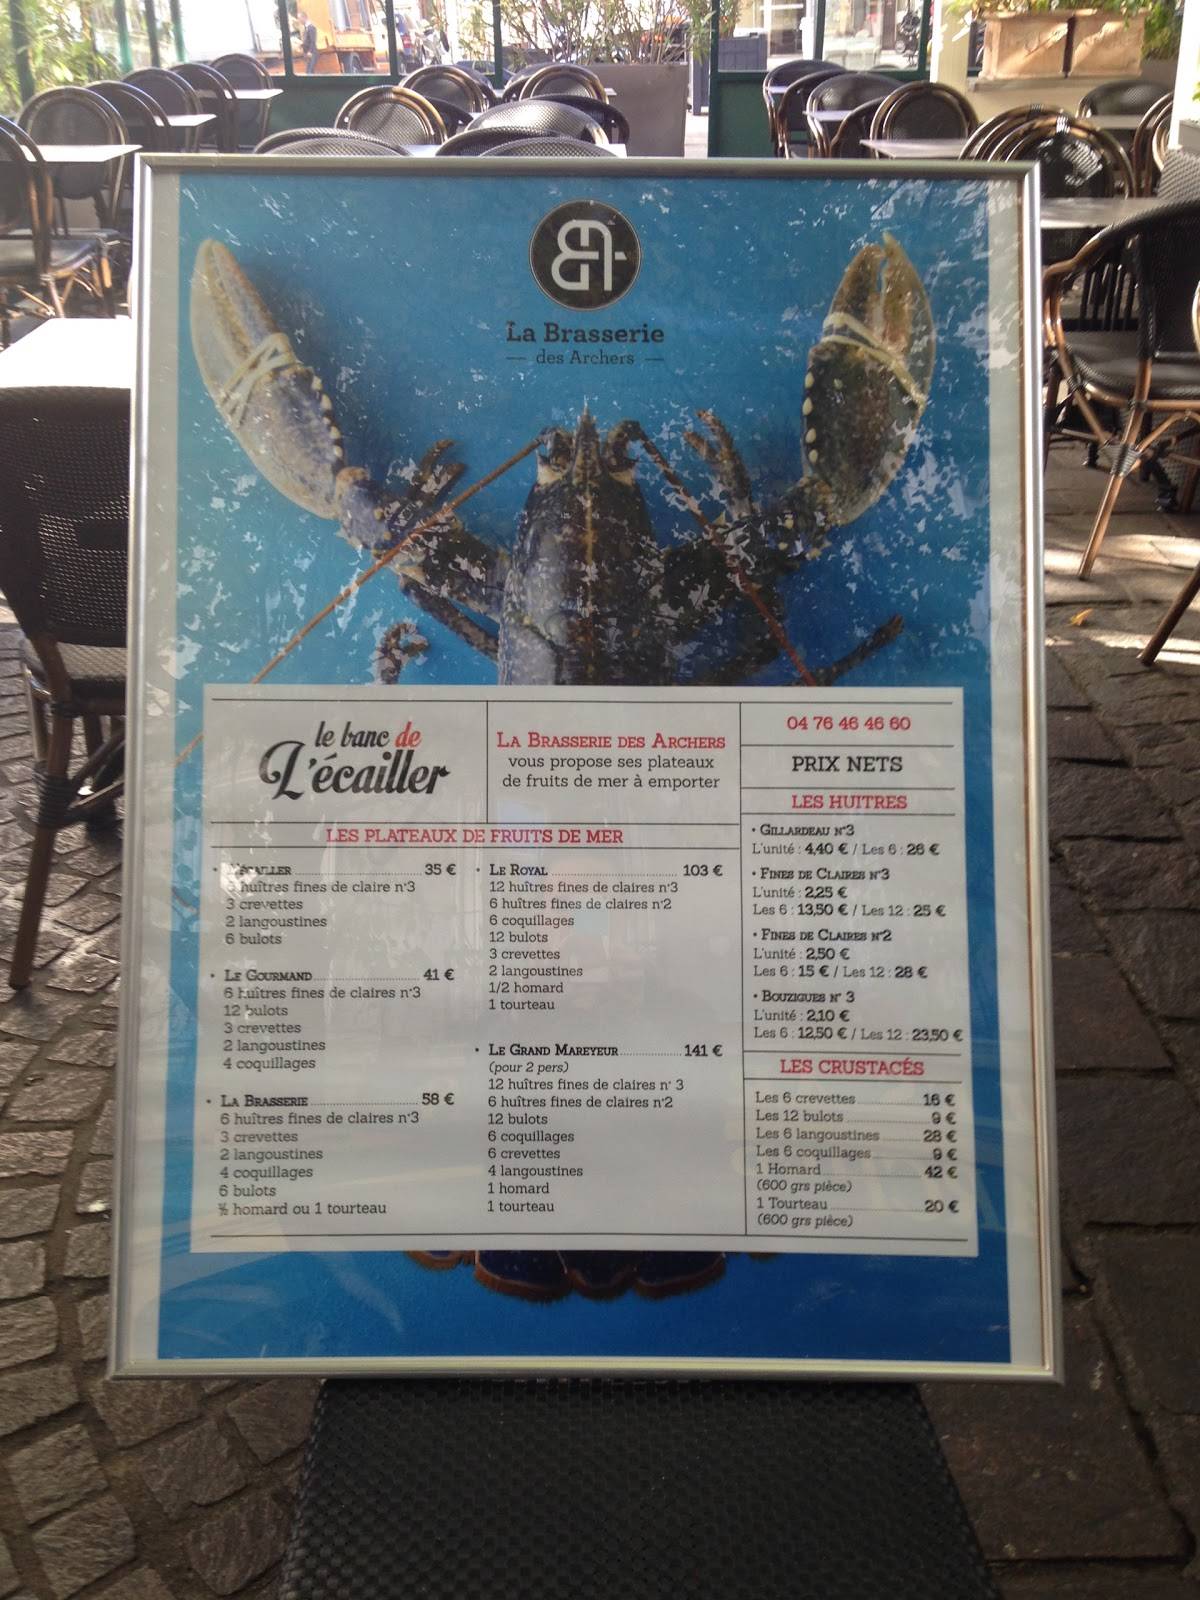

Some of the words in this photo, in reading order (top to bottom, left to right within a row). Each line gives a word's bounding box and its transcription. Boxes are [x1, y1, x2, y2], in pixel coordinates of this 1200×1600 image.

[506, 321, 536, 342] La
[544, 321, 665, 342] Brasserie
[536, 349, 564, 365] des
[569, 349, 635, 365] Archers
[787, 717, 808, 730] 04
[814, 717, 833, 730] 76
[839, 717, 859, 730] 46
[864, 717, 884, 730] 46
[890, 717, 911, 730] 60
[315, 721, 335, 748] le
[341, 721, 390, 748] banc
[395, 721, 422, 748] de
[497, 732, 521, 749] LA
[528, 732, 612, 749] BRASSERIE
[618, 732, 645, 749] DES
[652, 732, 726, 749] ARCHERS
[508, 756, 544, 768] vous
[550, 758, 612, 771] propose
[618, 758, 642, 768] ses
[648, 754, 714, 771] plateaux
[792, 756, 840, 773] PRIX
[847, 756, 903, 773] NETS
[259, 740, 450, 800] L'écailler
[502, 776, 521, 788] de
[526, 775, 568, 788] fruits
[574, 776, 592, 788] de
[598, 777, 628, 788] mer
[634, 775, 642, 788] à
[648, 777, 720, 790] emporter
[792, 795, 824, 809] LES
[830, 795, 908, 809] HUITRES
[326, 829, 359, 843] LES
[365, 829, 457, 843] PLATEAUX
[462, 830, 485, 843] DE
[490, 830, 553, 843] FRUITS
[558, 830, 581, 844] DE
[586, 830, 624, 844] MER
[752, 843, 796, 856] L'unité
[805, 843, 833, 856] 4,40
[862, 843, 884, 856] Les
[907, 843, 925, 856] 26
[425, 863, 442, 876] 35
[683, 864, 708, 876] 103
[294, 881, 327, 893] fines
[352, 881, 390, 893] claire
[490, 881, 504, 894] 12
[508, 881, 554, 894] huîtres
[558, 881, 588, 894] fines
[612, 881, 654, 894] claires
[753, 886, 796, 898] L'unité
[805, 886, 833, 898] 2,25
[240, 899, 303, 911] crevettes
[502, 898, 546, 910] huîtres
[551, 898, 582, 910] fines
[606, 898, 648, 910] claires
[753, 904, 775, 917] Les
[798, 904, 833, 917] 13,50
[862, 904, 884, 917] Les
[913, 904, 931, 917] 25
[240, 915, 328, 930] langoustines
[502, 915, 574, 929] coquillages
[240, 933, 282, 945] bulots
[490, 932, 504, 943] 12
[509, 932, 548, 943] bulots
[501, 949, 560, 960] crevettes
[753, 948, 797, 960] L'unité
[806, 948, 836, 960] 2,50
[423, 969, 439, 982] 41
[502, 966, 583, 978] langoustines
[753, 965, 776, 978] Les
[798, 965, 814, 978] 15
[843, 965, 866, 978] Les
[895, 965, 913, 978] 28
[238, 987, 286, 999] huîtres
[291, 987, 324, 999] fines
[350, 987, 395, 999] claires
[489, 982, 510, 994] 1/2
[514, 982, 564, 994] homard
[224, 1005, 240, 1017] 12
[245, 1005, 288, 1017] bulots
[500, 1000, 555, 1011] tourteau
[754, 1009, 796, 1022] L'unité
[807, 1009, 835, 1022] 2,10
[237, 1023, 301, 1034] crevettes
[754, 1027, 776, 1038] Les
[798, 1027, 833, 1040] 12,50
[861, 1027, 883, 1041] Les
[912, 1027, 949, 1041] 23,50
[237, 1039, 326, 1054] langoustines
[684, 1044, 708, 1056] 141
[236, 1057, 316, 1072] coquillages
[489, 1062, 522, 1074] (pour
[526, 1063, 534, 1073] 2
[537, 1062, 569, 1074] pers)
[780, 1060, 812, 1073] LES
[819, 1058, 925, 1075] CRUSTACÉS
[489, 1078, 503, 1090] 12
[508, 1078, 554, 1090] huîtres
[558, 1078, 589, 1090] fines
[613, 1078, 656, 1090] claires
[422, 1093, 439, 1107] 58
[501, 1096, 546, 1108] huîtres
[550, 1096, 582, 1108] fines
[606, 1096, 648, 1108] claires
[755, 1092, 778, 1104] Les
[796, 1094, 856, 1104] crevettes
[924, 1094, 941, 1106] 16
[235, 1112, 283, 1126] huîtres
[288, 1112, 322, 1126] fines
[347, 1112, 393, 1126] claires
[488, 1114, 503, 1125] 12
[508, 1114, 548, 1125] bulots
[756, 1110, 779, 1121] Les
[784, 1111, 799, 1121] 12
[803, 1111, 843, 1122] bulots
[234, 1131, 298, 1143] crevettes
[501, 1131, 575, 1144] coquillages
[756, 1128, 779, 1139] Les
[797, 1128, 880, 1143] langoustines
[923, 1131, 942, 1142] 28
[234, 1149, 323, 1164] langoustines
[501, 1148, 560, 1160] crevettes
[756, 1146, 779, 1156] Les
[796, 1146, 871, 1160] coquillages
[233, 1166, 314, 1181] coquillages
[500, 1165, 583, 1179] langoustines
[768, 1164, 821, 1175] Homard
[925, 1167, 943, 1178] 42
[233, 1185, 277, 1198] bulots
[500, 1183, 550, 1194] homard
[757, 1181, 786, 1193] (600
[791, 1183, 810, 1193] grs
[814, 1181, 852, 1193] pièce)
[233, 1202, 288, 1216] homard
[293, 1202, 310, 1216] ou
[314, 1202, 322, 1216] 1
[328, 1202, 387, 1216] tourteau
[499, 1201, 554, 1212] tourteau
[769, 1198, 828, 1210] Tourteau
[925, 1201, 944, 1212] 20
